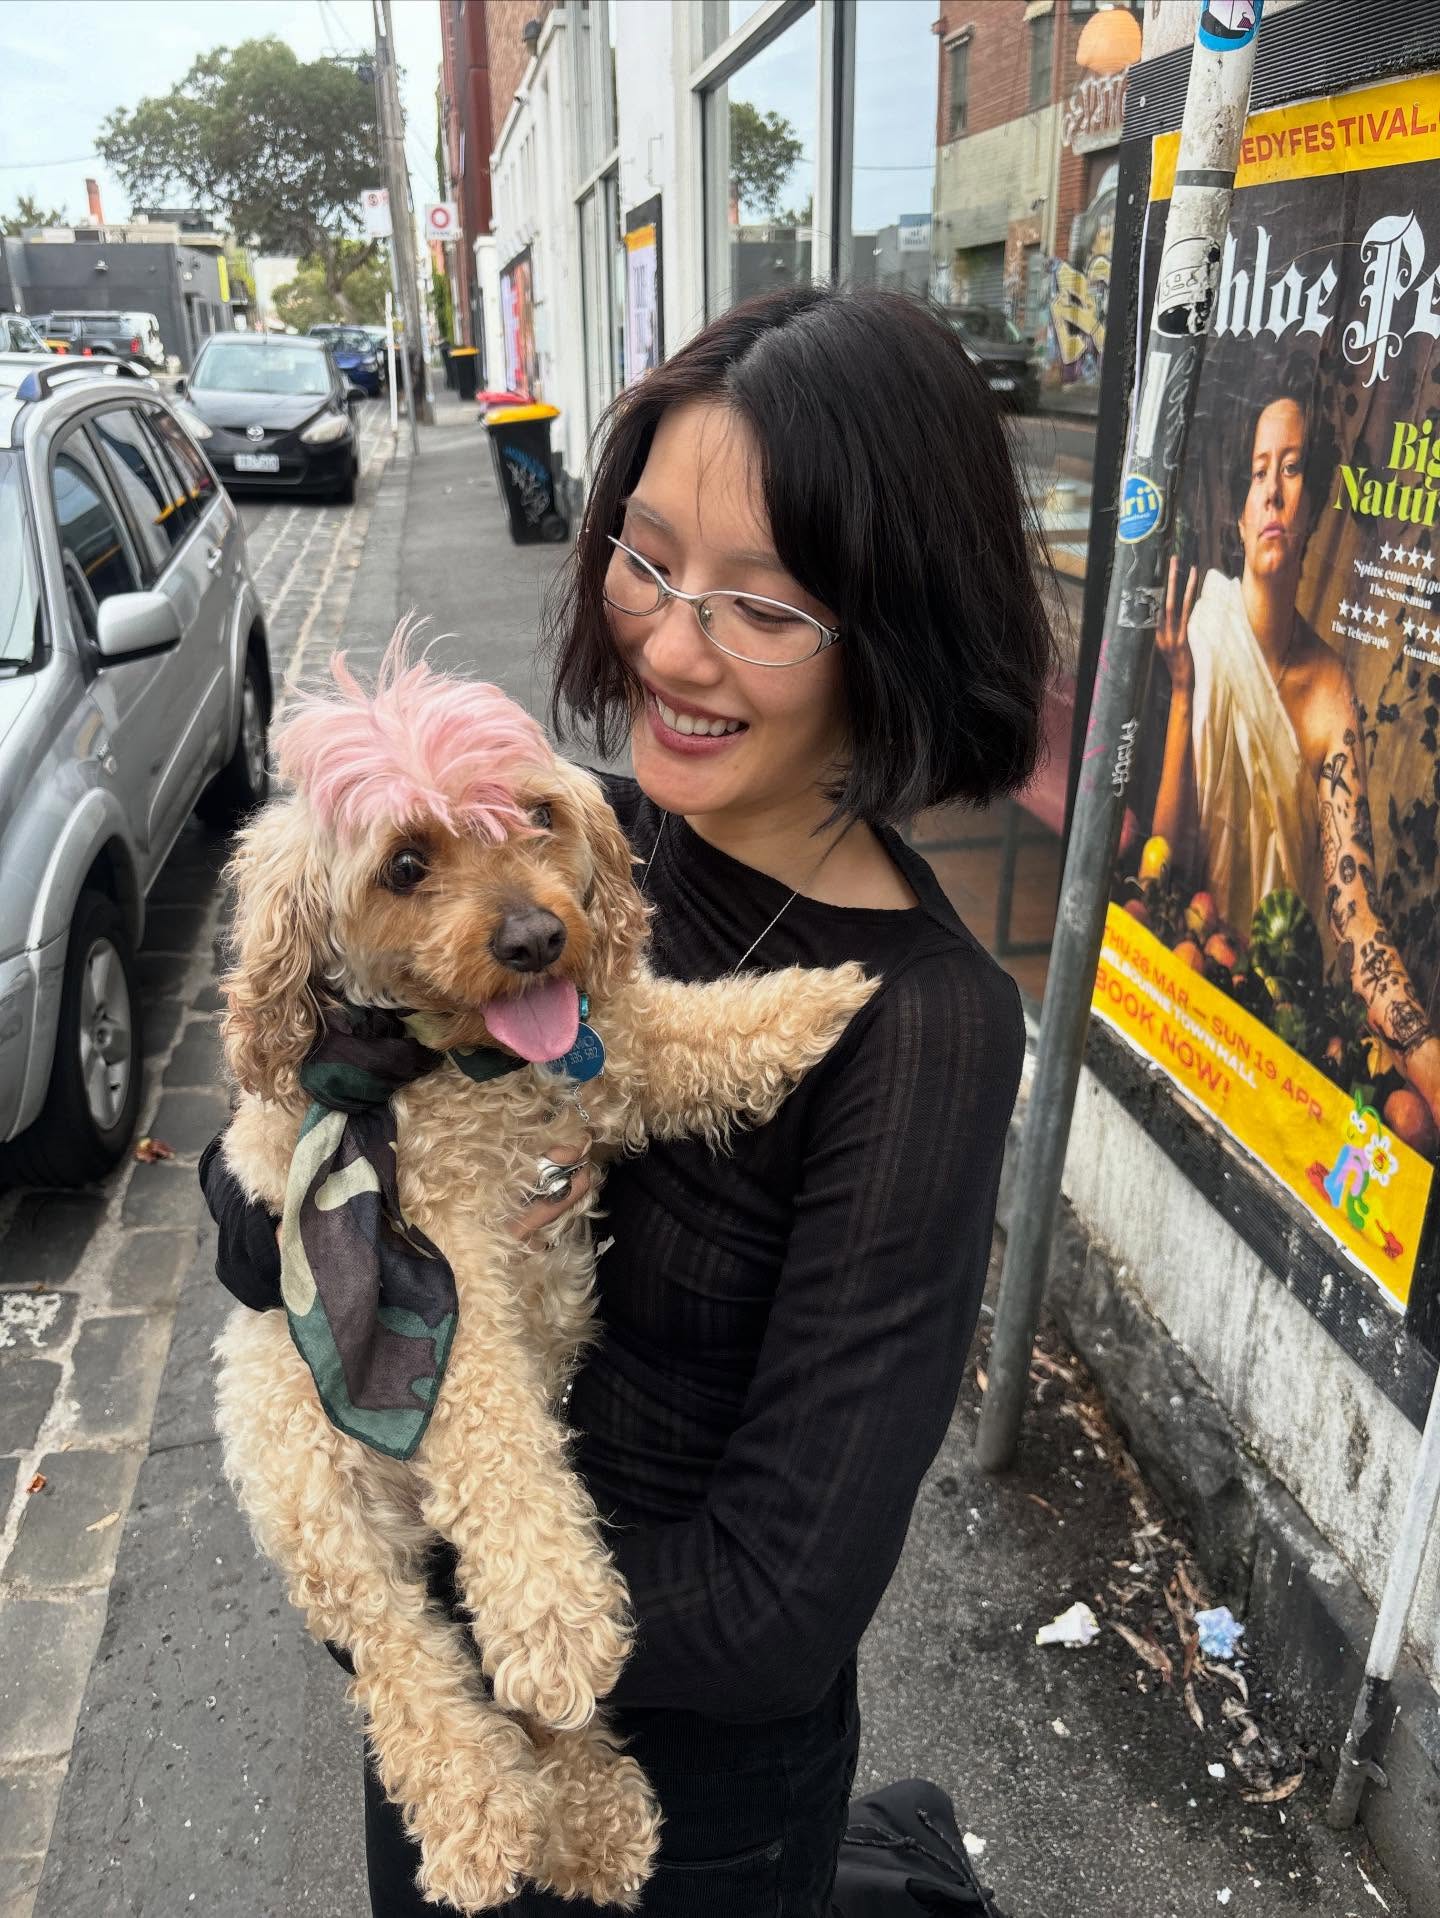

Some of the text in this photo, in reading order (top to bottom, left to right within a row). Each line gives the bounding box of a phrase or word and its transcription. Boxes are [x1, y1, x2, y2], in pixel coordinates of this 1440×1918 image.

[1239, 106, 1440, 165] EDYFESTIVAL.
[1214, 223, 1338, 343] hloe
[1095, 967, 1230, 1104] BOOK NOW!
[1152, 967, 1189, 1010] MAR
[1211, 1015, 1251, 1059] SUN
[1253, 1050, 1277, 1080] 19
[1281, 1076, 1323, 1123] APR
